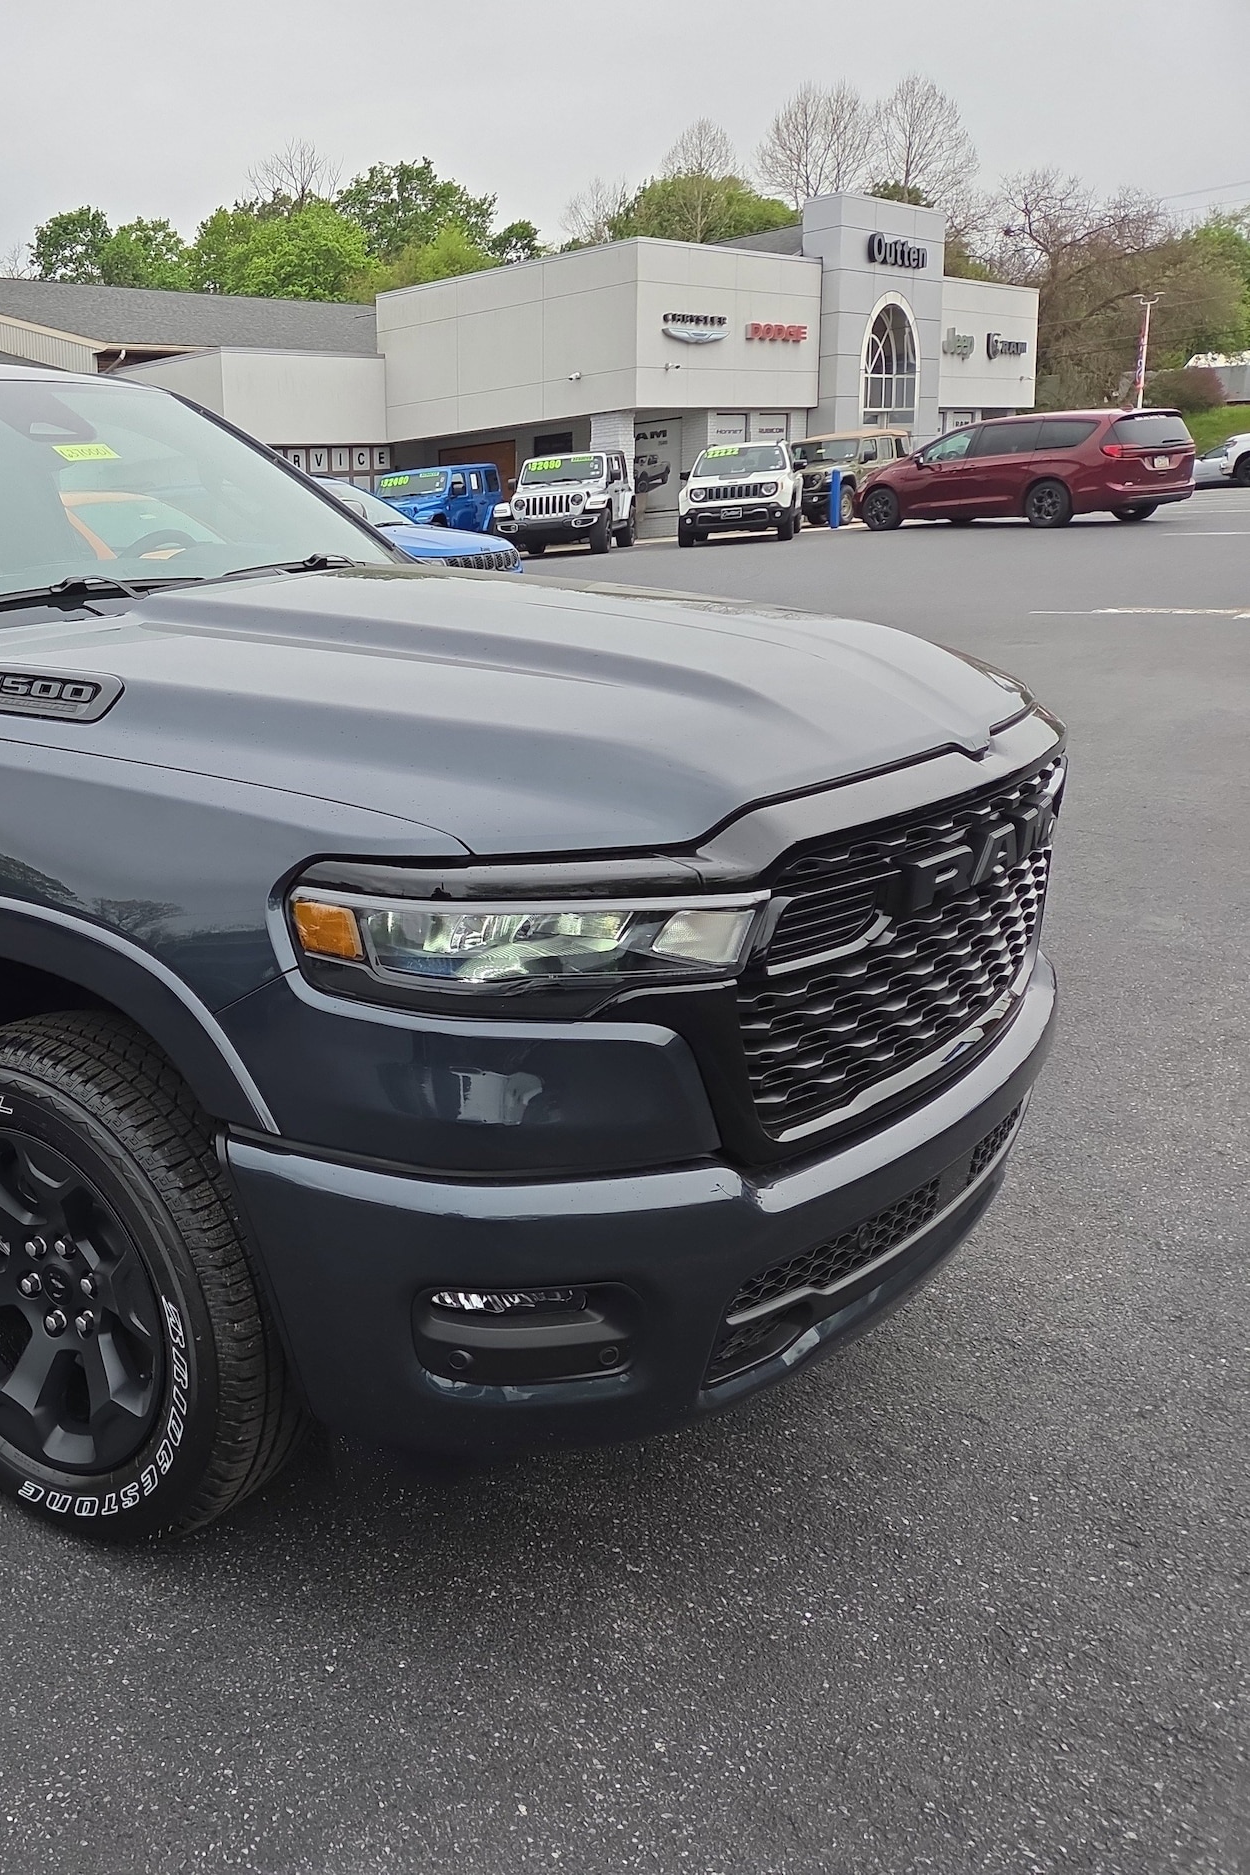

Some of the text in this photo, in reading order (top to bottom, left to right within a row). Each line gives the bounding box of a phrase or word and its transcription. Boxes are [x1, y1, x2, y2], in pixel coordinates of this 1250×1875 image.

[868, 232, 928, 269] Outten
[662, 312, 727, 326] CHRYSLER
[746, 322, 808, 342] DODGE
[942, 327, 975, 360] Jeep
[1000, 340, 1027, 355] RAM
[635, 429, 668, 441] AM
[292, 450, 385, 468] RVICE
[905, 794, 1053, 913] RAM
[17, 1295, 188, 1517] BRIDGESTONE
